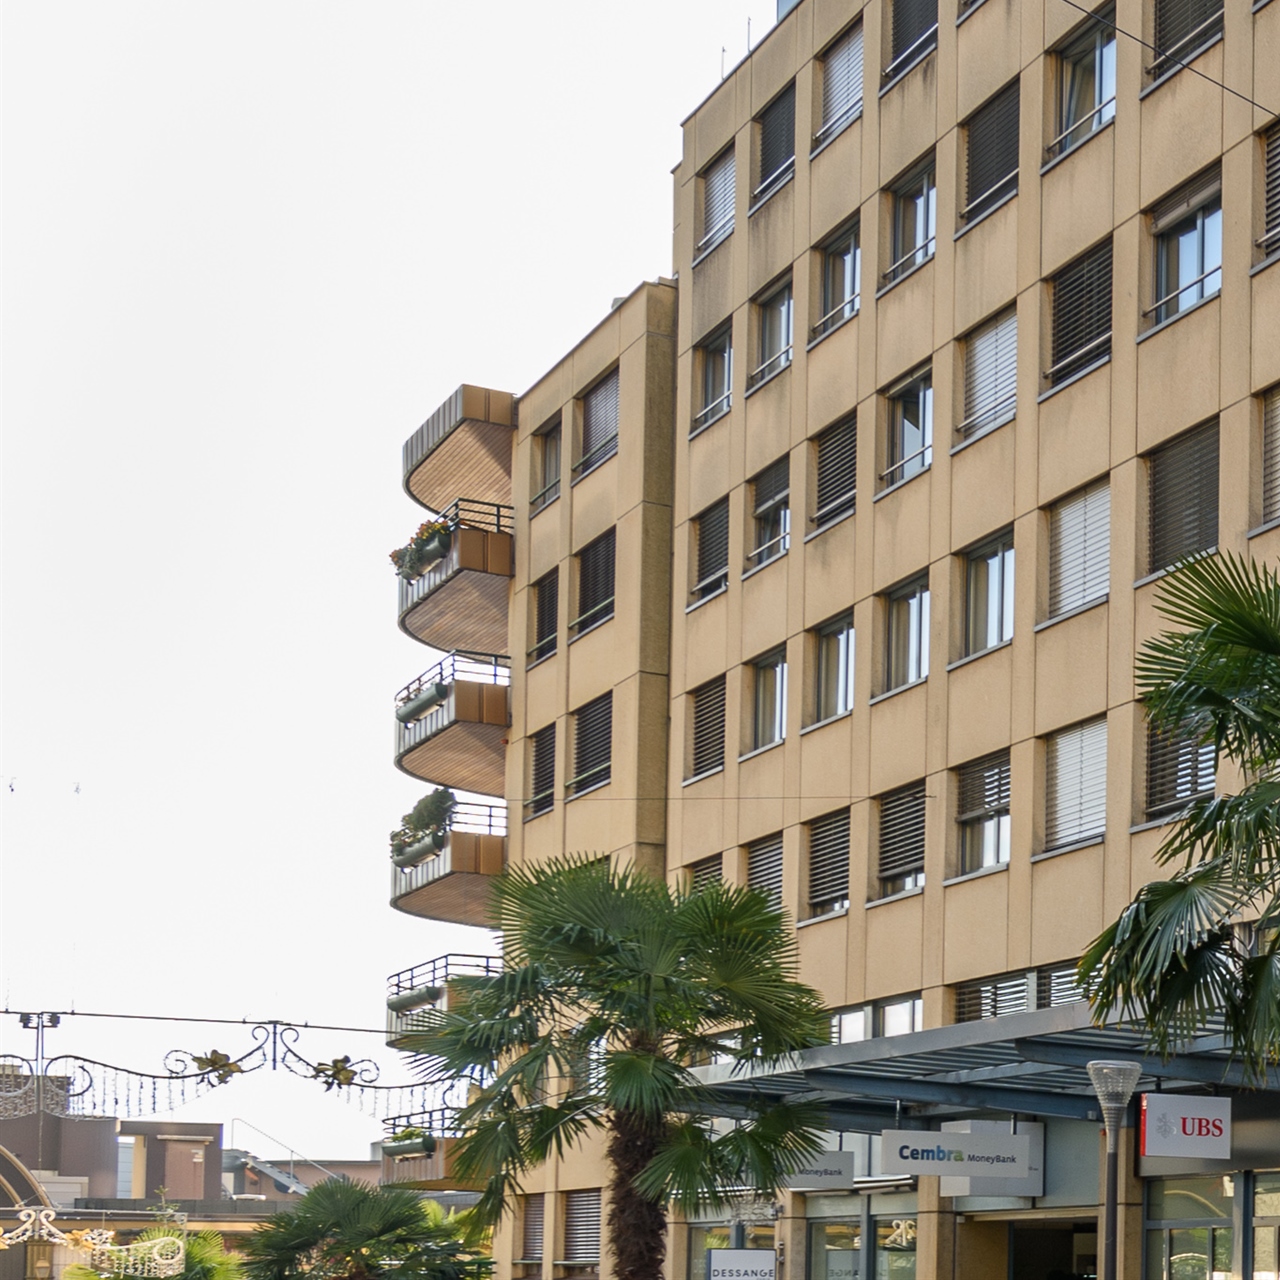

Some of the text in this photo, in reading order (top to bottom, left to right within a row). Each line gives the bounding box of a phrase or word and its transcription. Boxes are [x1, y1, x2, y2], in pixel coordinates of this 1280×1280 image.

[1180, 1116, 1224, 1138] UBS
[899, 1144, 1017, 1165] Cembra MoneyBank
[712, 1269, 774, 1277] DESSANGE
